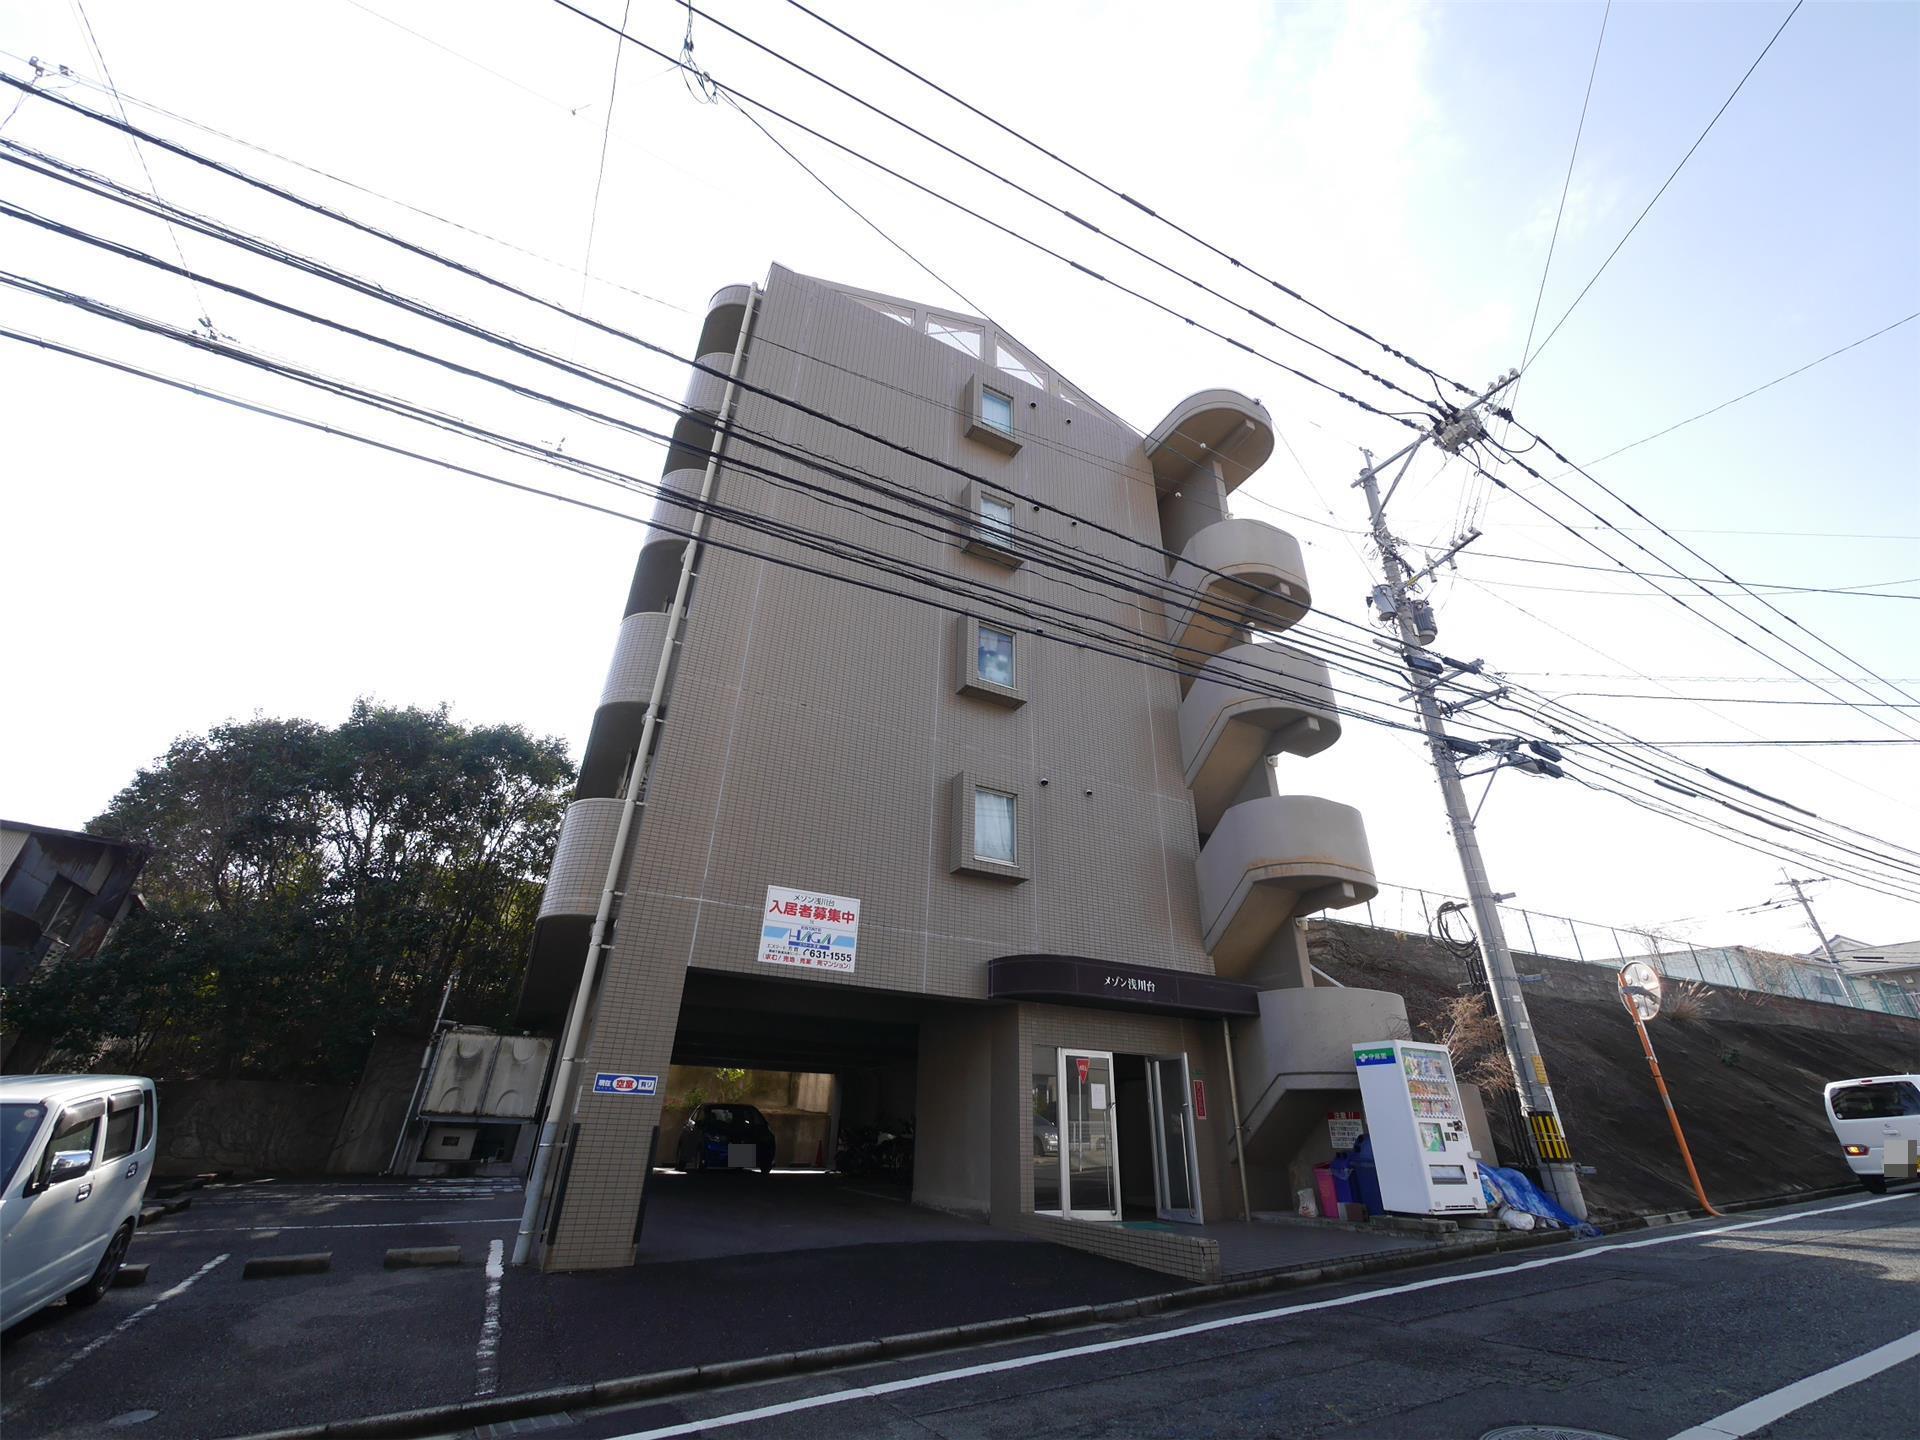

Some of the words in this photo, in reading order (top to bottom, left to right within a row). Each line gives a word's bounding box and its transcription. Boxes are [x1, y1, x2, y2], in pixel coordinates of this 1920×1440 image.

[769, 900, 855, 925] 入居者募集中
[809, 949, 852, 962] 631-1555
[1104, 976, 1155, 992] メゾン浅川台
[616, 1079, 634, 1088] 空室
